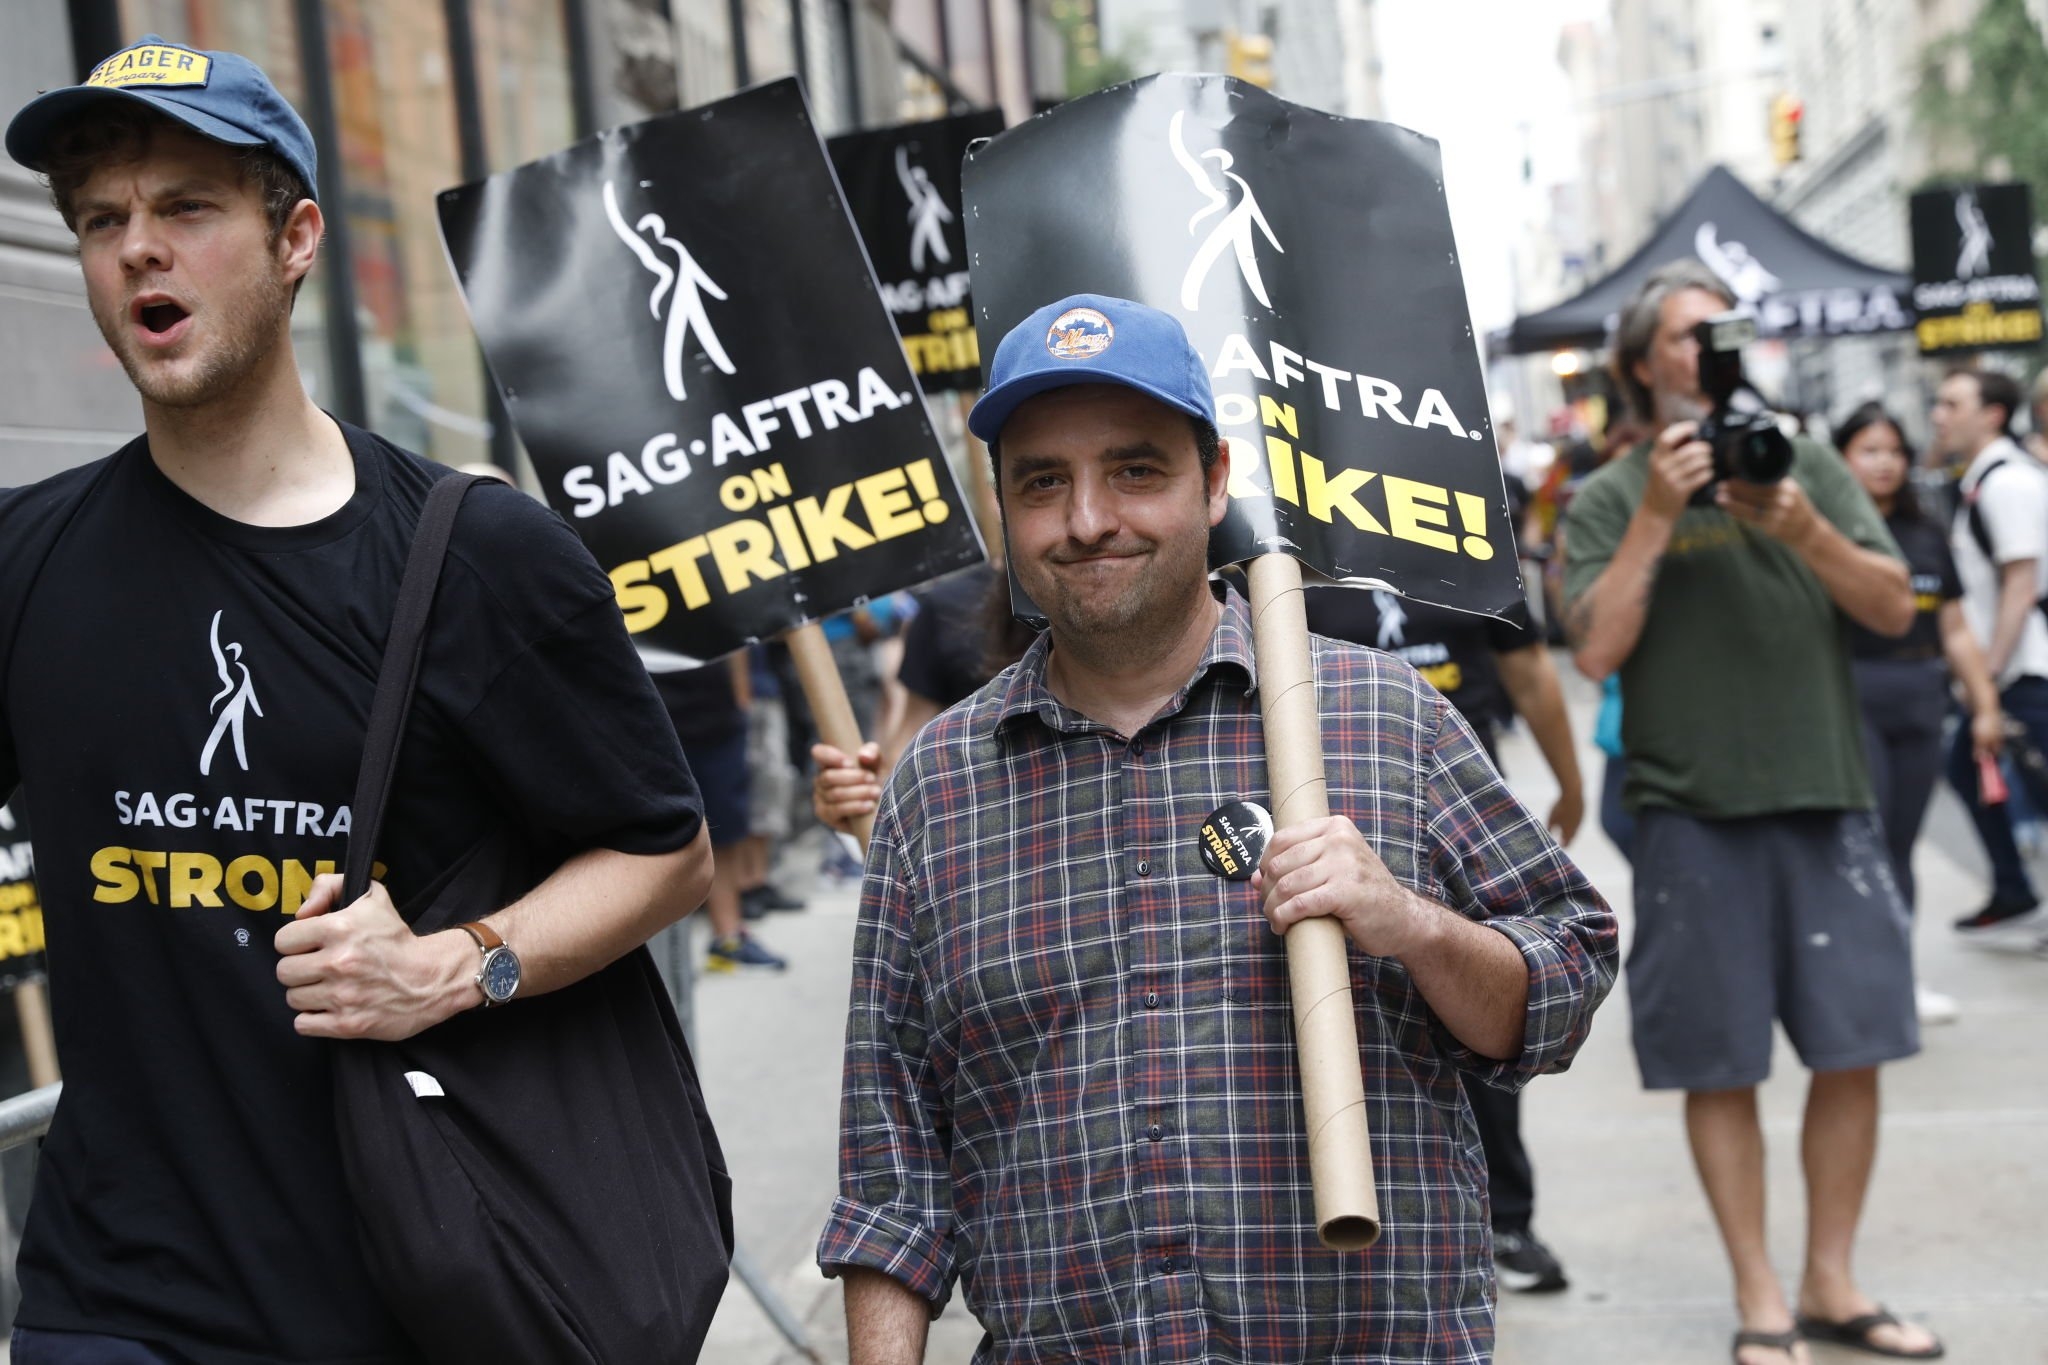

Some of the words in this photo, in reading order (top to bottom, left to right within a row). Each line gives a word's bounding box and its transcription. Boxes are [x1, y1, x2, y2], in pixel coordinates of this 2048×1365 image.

[1211, 333, 1470, 439] AFTRA
[1215, 393, 1299, 439] ON
[719, 462, 792, 512] ON
[1226, 435, 1494, 561] RIKE!
[607, 457, 950, 635] STRIKE!
[1201, 824, 1239, 875] STRIKE!
[1223, 838, 1233, 850] ON
[90, 846, 387, 915] STRON
